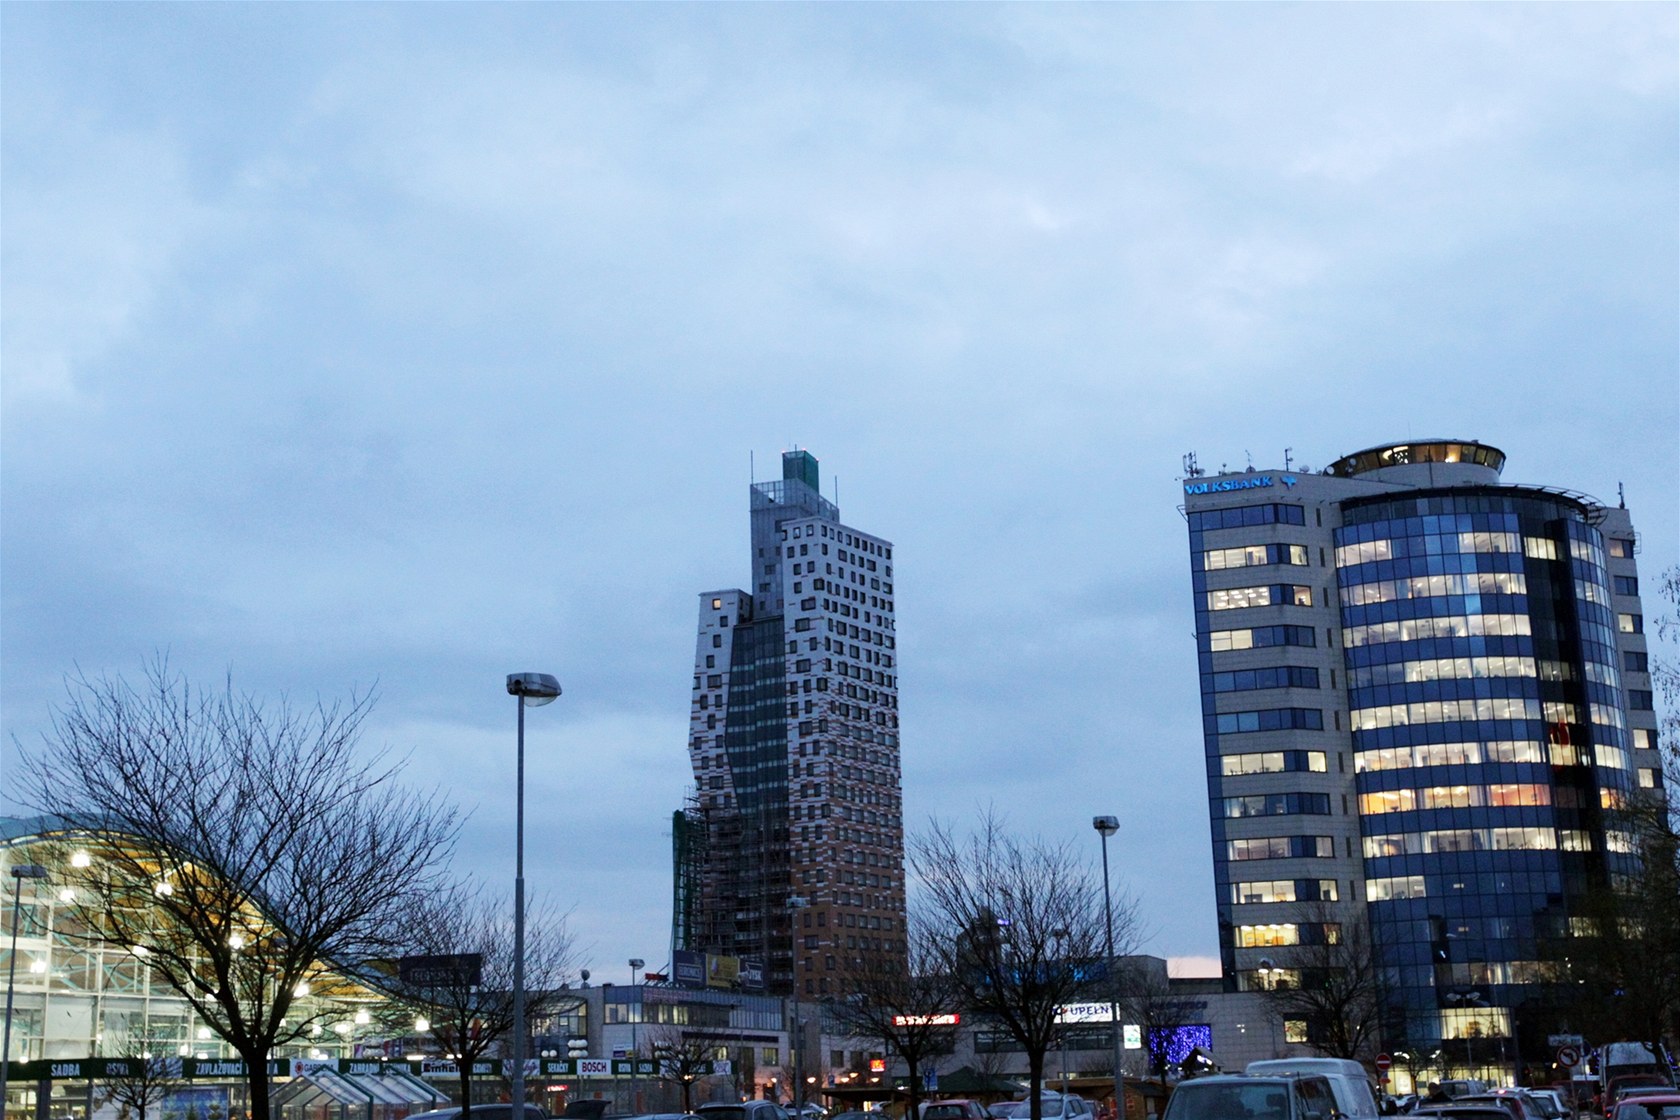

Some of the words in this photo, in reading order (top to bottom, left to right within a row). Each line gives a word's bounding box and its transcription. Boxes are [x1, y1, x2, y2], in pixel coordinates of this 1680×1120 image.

[1184, 476, 1273, 495] VOLKSBANK
[51, 1063, 80, 1076] SADBA
[423, 1063, 463, 1074] Einhel
[581, 1062, 607, 1073] BOSCH
